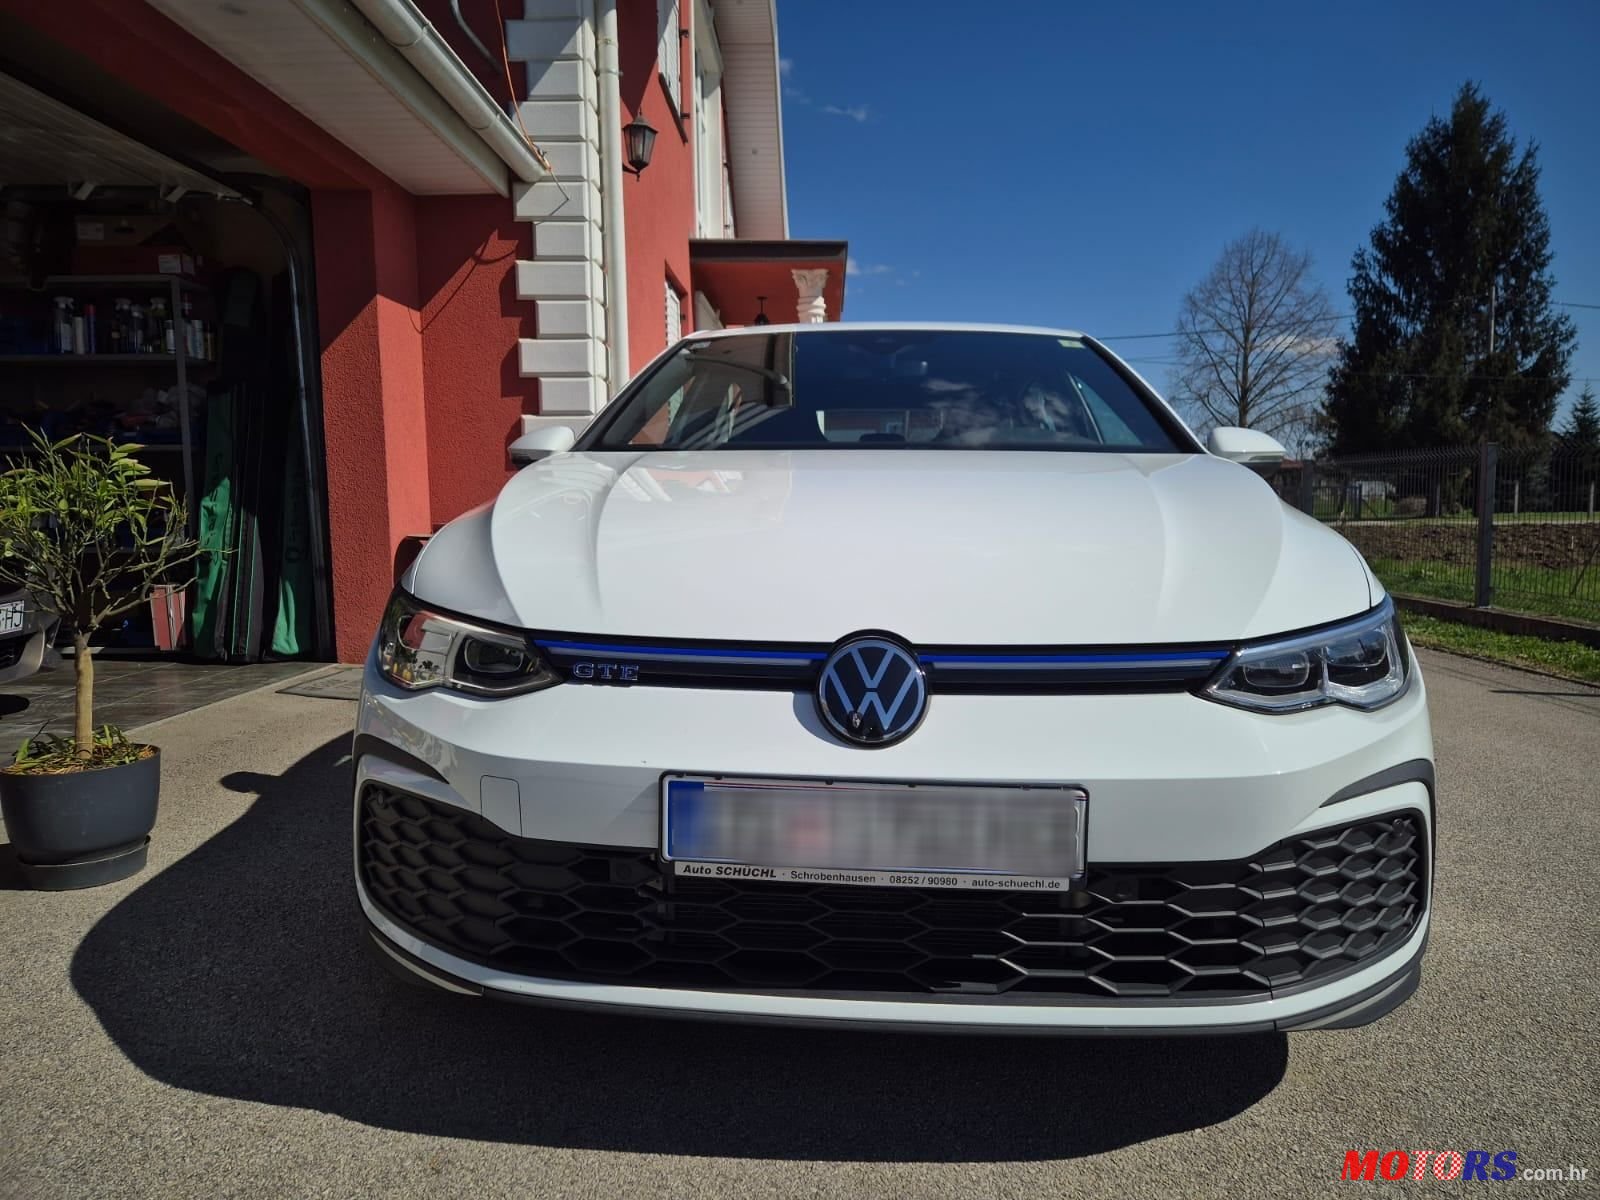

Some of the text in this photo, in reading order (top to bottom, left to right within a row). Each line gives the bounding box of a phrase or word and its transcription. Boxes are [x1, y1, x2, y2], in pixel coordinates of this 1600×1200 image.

[572, 661, 640, 681] GTE
[682, 864, 712, 875] Auto
[715, 865, 777, 879] SCHÜCHL
[790, 870, 876, 884] Schrobenhausen
[889, 875, 920, 885] 08252
[927, 876, 958, 886] 90980
[971, 878, 1061, 889] auto-schuechl.de
